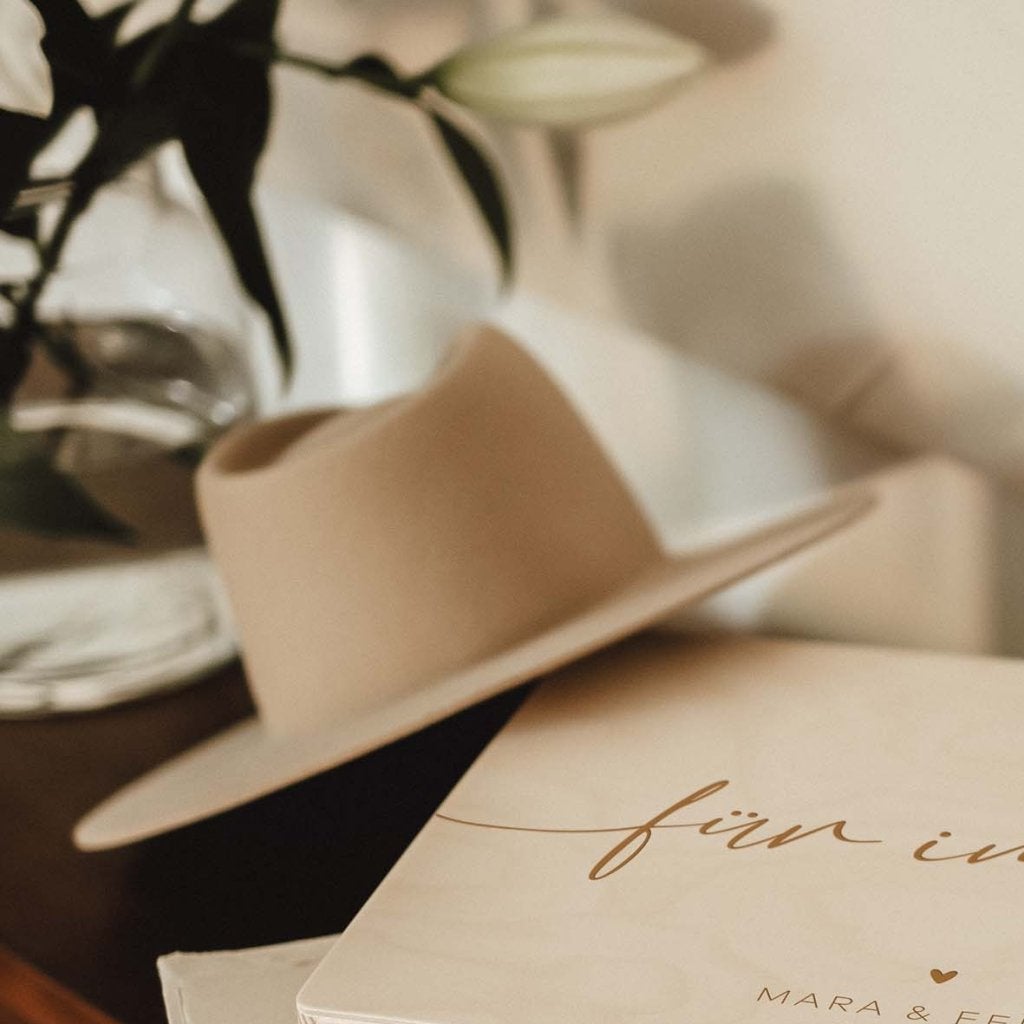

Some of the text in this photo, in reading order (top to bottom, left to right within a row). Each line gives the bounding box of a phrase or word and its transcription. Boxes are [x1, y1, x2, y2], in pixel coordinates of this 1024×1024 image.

[436, 779, 882, 881] für
[756, 987, 882, 1017] MARA
[906, 1005, 931, 1022] &
